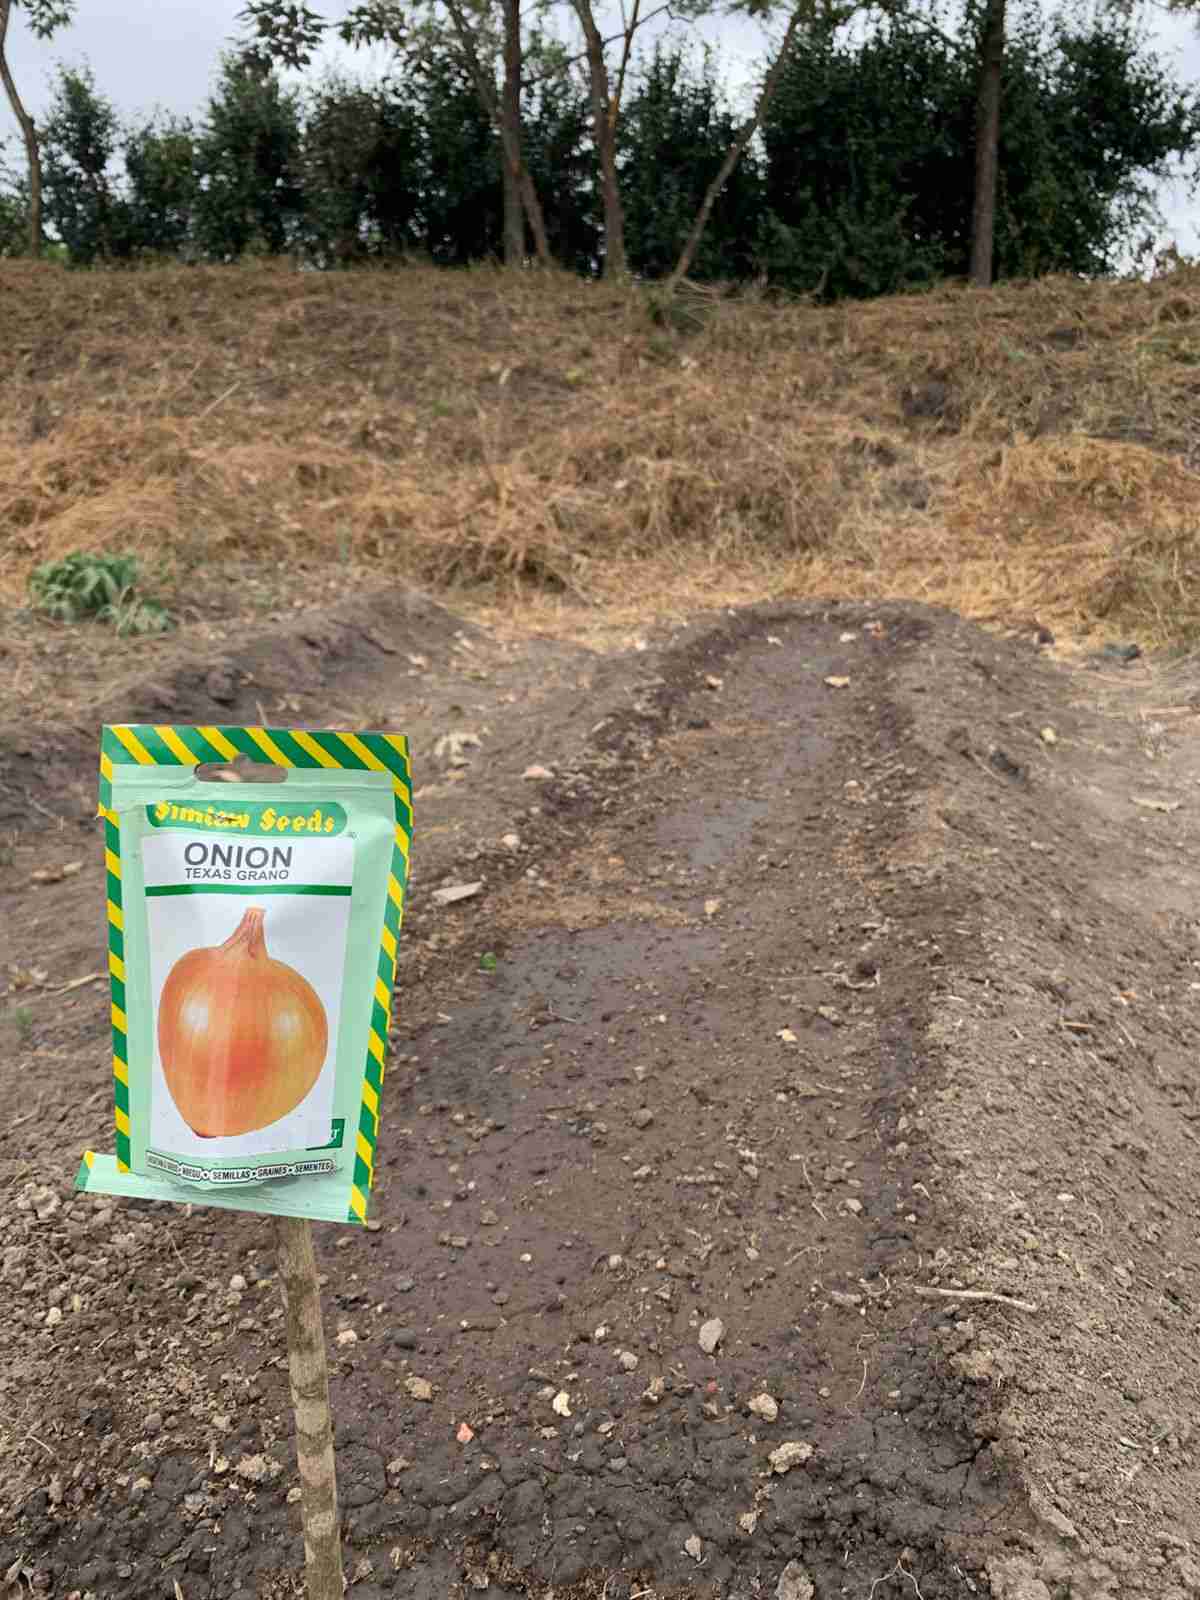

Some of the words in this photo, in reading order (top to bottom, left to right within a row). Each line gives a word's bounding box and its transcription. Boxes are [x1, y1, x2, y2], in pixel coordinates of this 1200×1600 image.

[259, 808, 335, 832] Seeds
[184, 842, 292, 869] ONION
[185, 868, 232, 880] TEXAS
[236, 869, 289, 881] GRANO
[212, 1171, 250, 1181] SEMILLAS
[258, 1167, 288, 1178] GRAINES
[294, 1161, 331, 1173] SEMENTES
